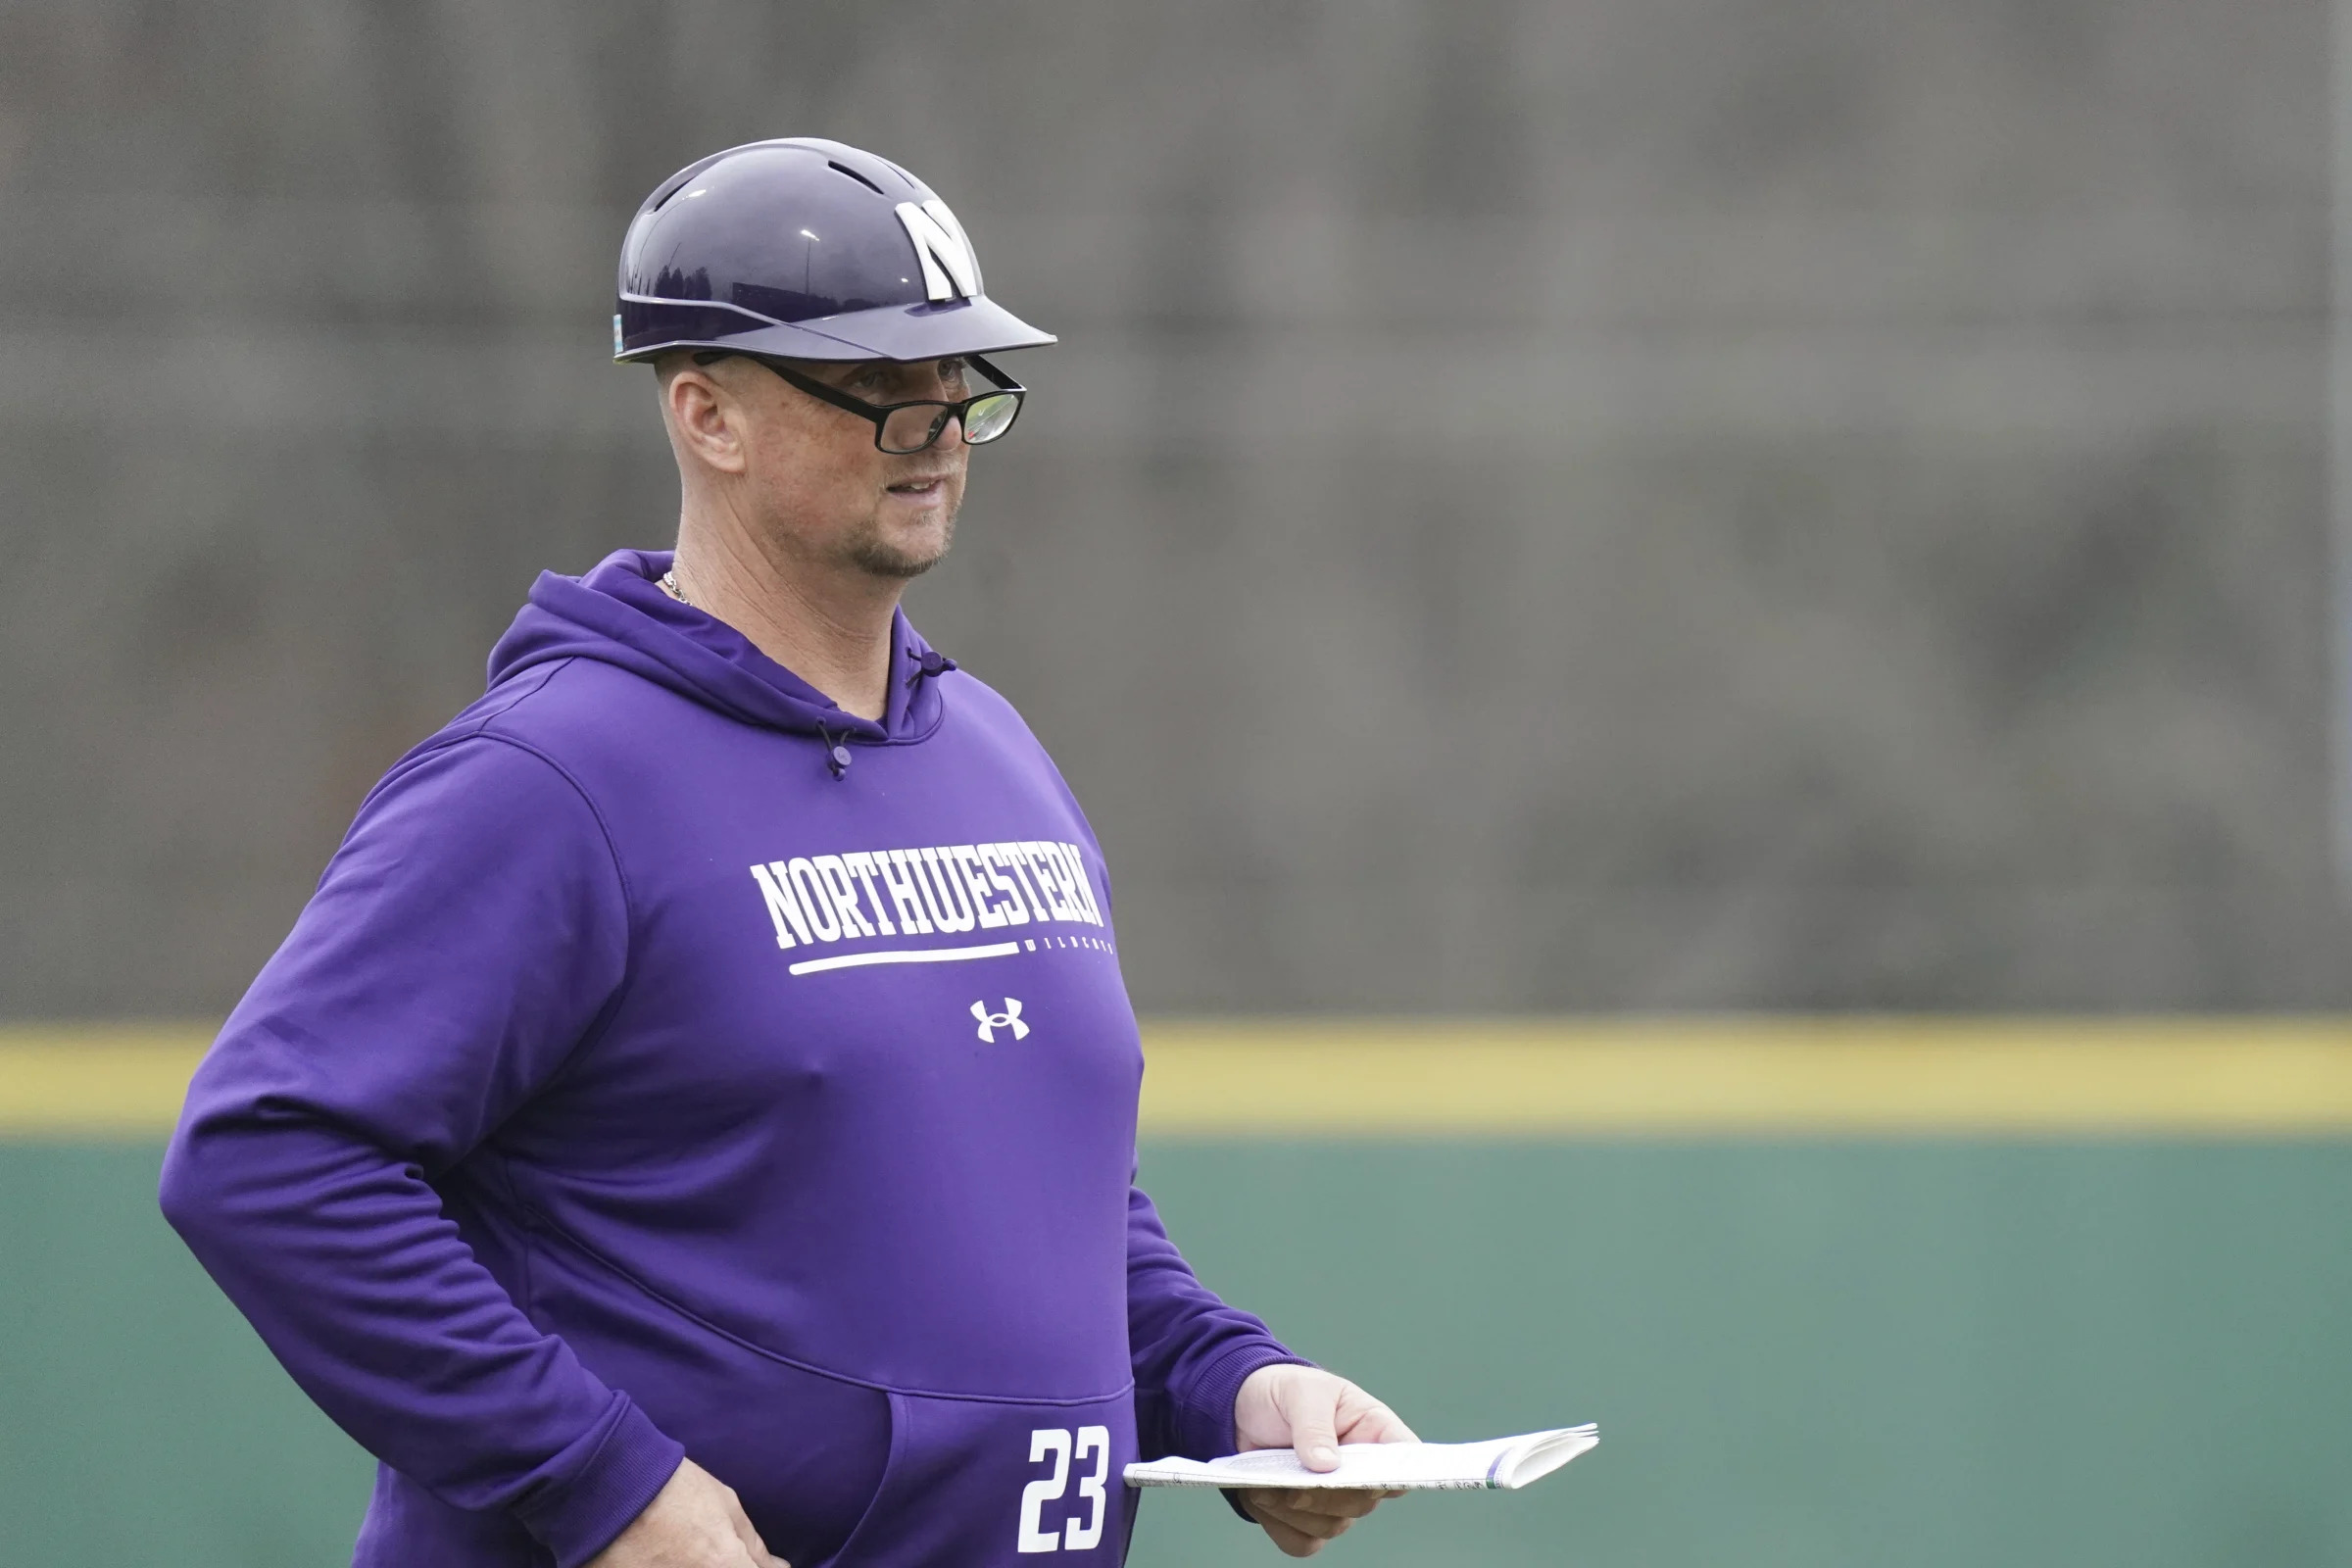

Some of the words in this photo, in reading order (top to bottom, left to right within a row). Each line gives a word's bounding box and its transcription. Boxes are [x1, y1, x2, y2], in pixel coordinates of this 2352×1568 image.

[894, 199, 978, 301] N
[750, 841, 1104, 950] NORTHWESTERN
[1017, 1425, 1109, 1553] 23
